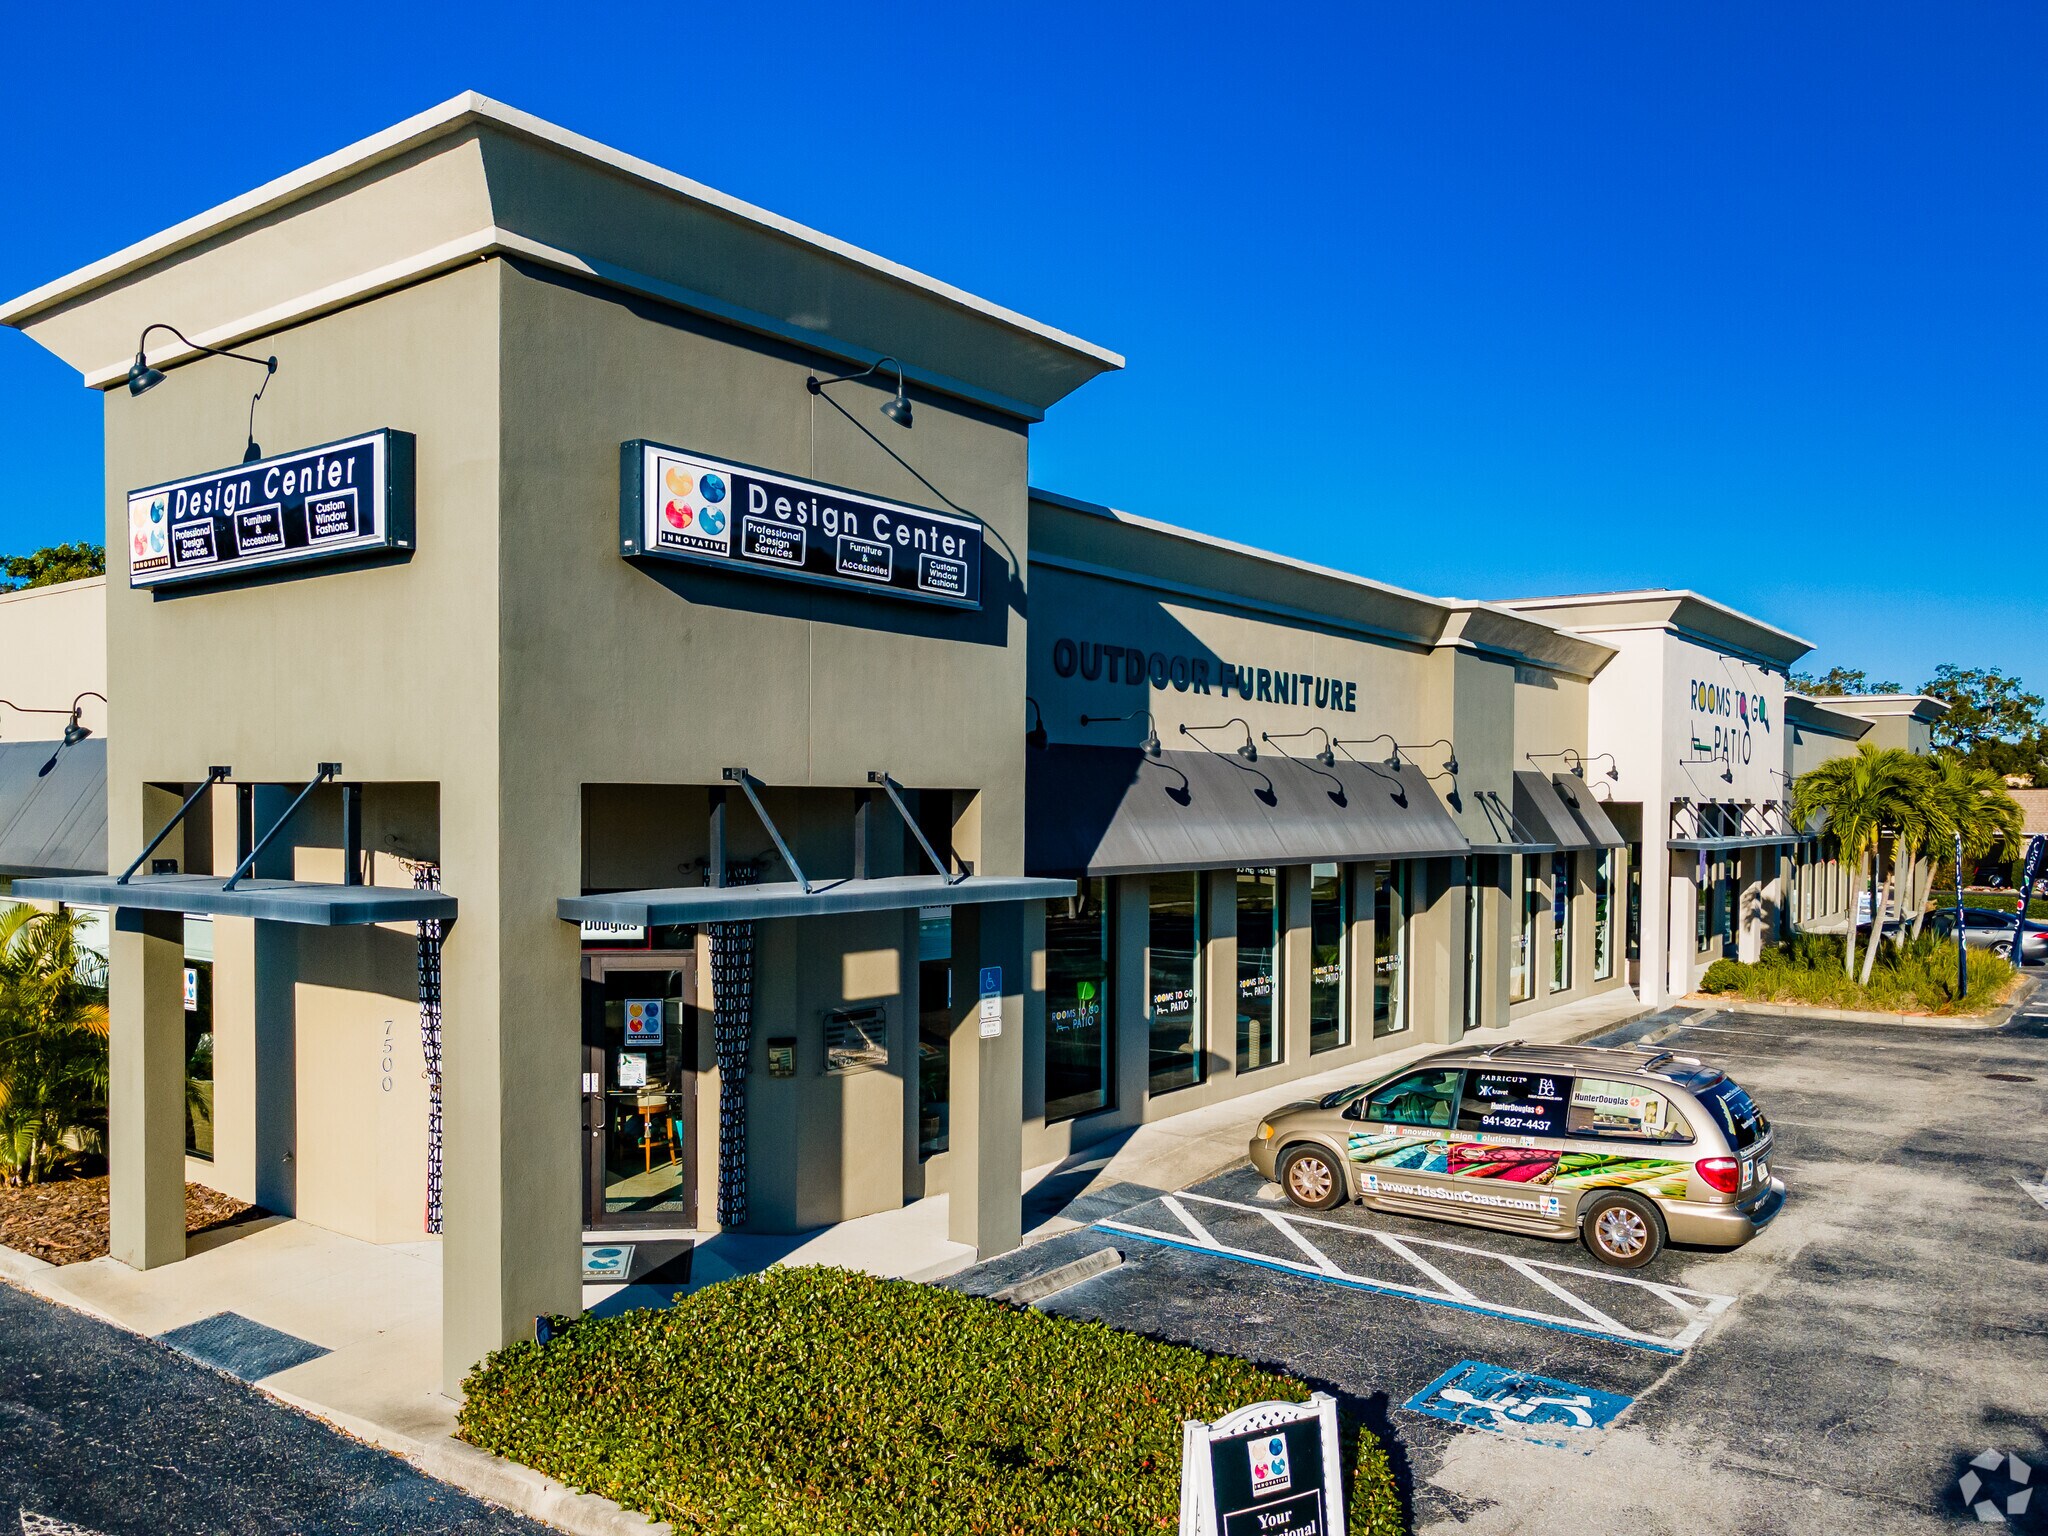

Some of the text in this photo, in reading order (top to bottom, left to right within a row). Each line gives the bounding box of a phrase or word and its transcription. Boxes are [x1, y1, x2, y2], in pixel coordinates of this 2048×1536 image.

[174, 456, 356, 518] Design Center
[316, 500, 345, 513] Custom
[244, 513, 272, 526] Furniture
[316, 510, 347, 524] Window
[748, 484, 966, 558] Design Center
[176, 525, 210, 540] Professional
[255, 525, 262, 534] &
[316, 521, 349, 536] Fashions
[748, 522, 801, 541] Professional
[182, 538, 204, 549] Design
[242, 532, 279, 547] Accessories
[662, 533, 727, 552] INNOVATIVE
[758, 533, 790, 551] Design
[182, 547, 208, 558] Services
[754, 542, 793, 559] Services
[849, 542, 883, 557] Furniture
[133, 558, 168, 570] INNOVATIVE
[862, 554, 868, 562] &
[842, 558, 888, 577] Accessories
[930, 560, 958, 573] Custom
[929, 569, 958, 582] Window
[927, 578, 958, 590] Fashions
[1054, 638, 1357, 712] OUTDOOR FURNITURE
[1691, 679, 1766, 723] ROOMS TO GO
[1715, 726, 1751, 765] PATIO
[1175, 990, 1183, 999] TO
[1184, 989, 1193, 998] GO
[1170, 1000, 1188, 1012] PATIO
[1052, 1009, 1076, 1021] ROOMS
[382, 1020, 393, 1092] 7500
[1481, 1074, 1523, 1083] FABRICUT
[1575, 1093, 1629, 1106] HunterDouglas
[1490, 1102, 1535, 1114] HunterDouglas
[1482, 1116, 1551, 1130] 941-927-4437
[1254, 1476, 1288, 1490] INNOVATIVE
[1257, 1510, 1292, 1529] Your
